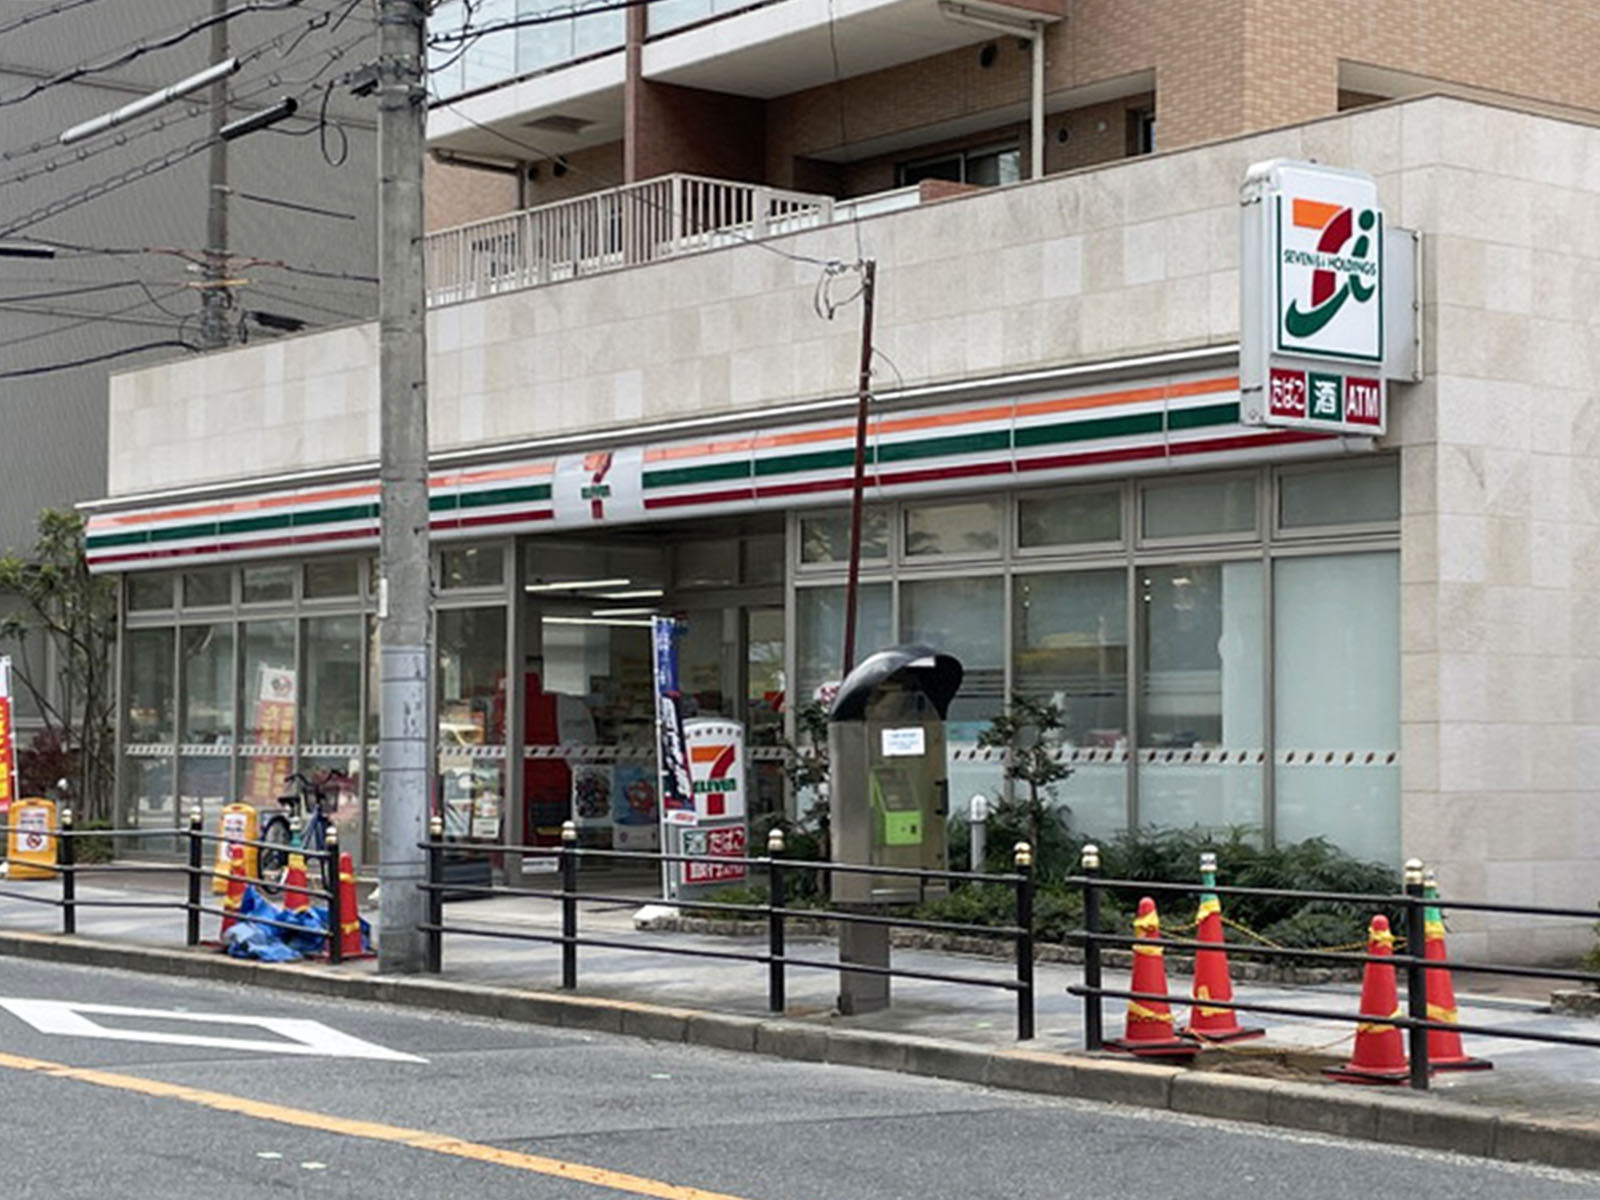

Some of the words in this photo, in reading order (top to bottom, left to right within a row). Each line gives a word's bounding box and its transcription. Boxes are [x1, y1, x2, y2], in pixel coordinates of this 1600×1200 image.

[1327, 256, 1377, 277] HOLDINGS
[1271, 376, 1305, 411] たばこ
[1314, 380, 1338, 415] 酒
[1346, 385, 1379, 418] ATM
[691, 744, 736, 815] 7
